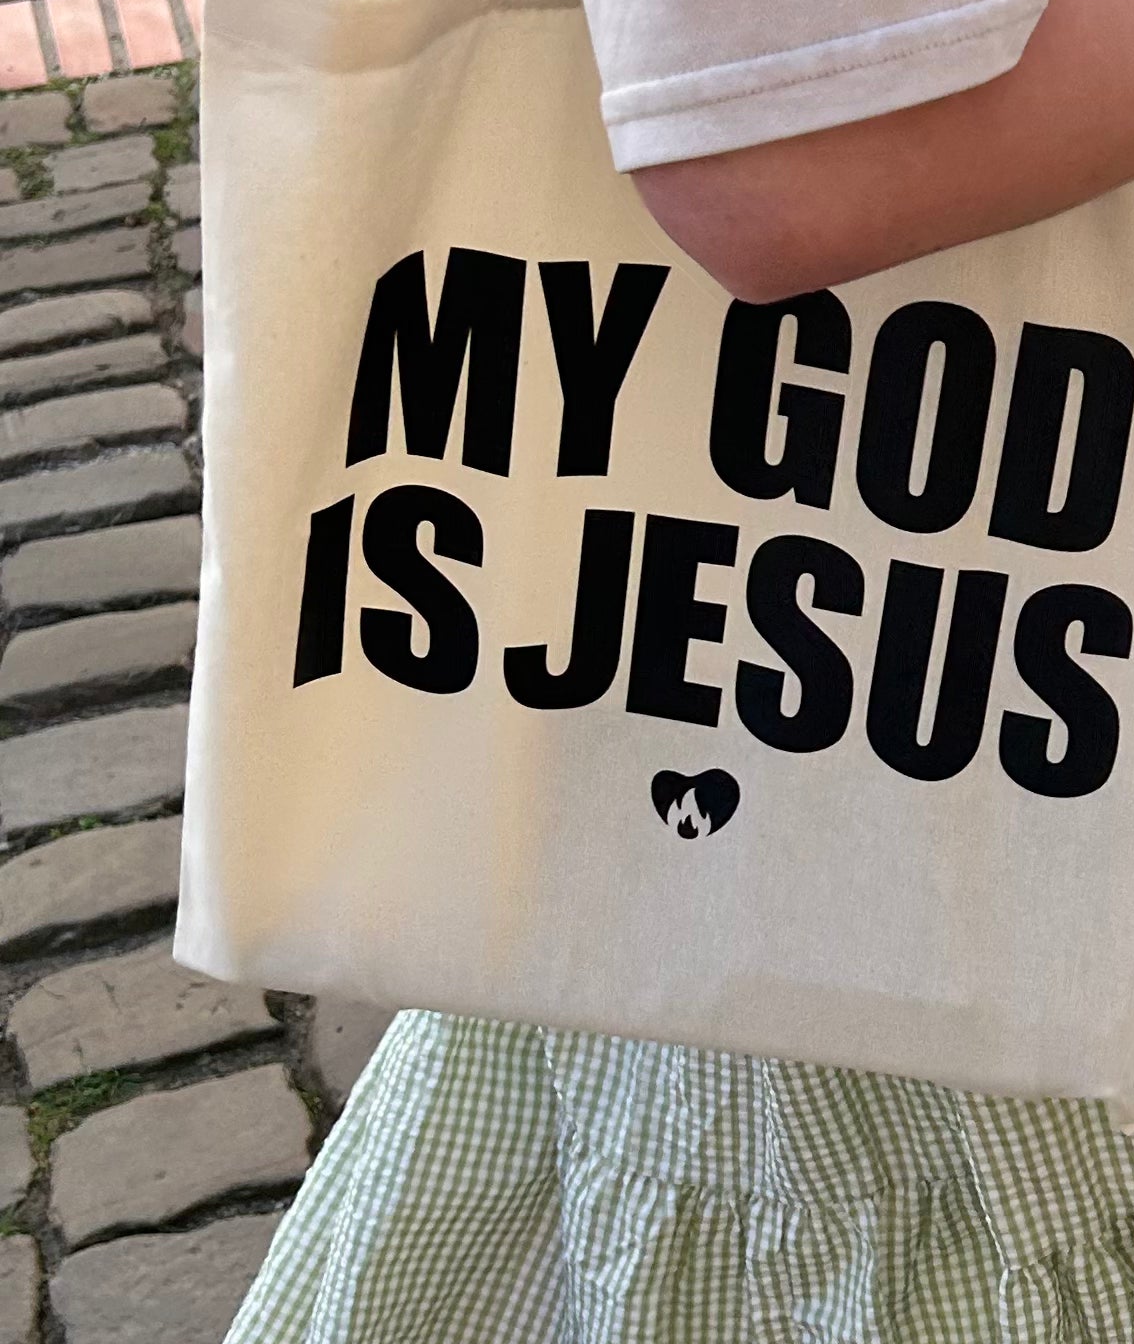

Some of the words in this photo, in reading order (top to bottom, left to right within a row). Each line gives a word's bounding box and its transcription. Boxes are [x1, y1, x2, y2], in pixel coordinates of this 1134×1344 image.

[346, 246, 672, 478] MY
[292, 484, 484, 695] IS
[503, 508, 1134, 799] JESUS
